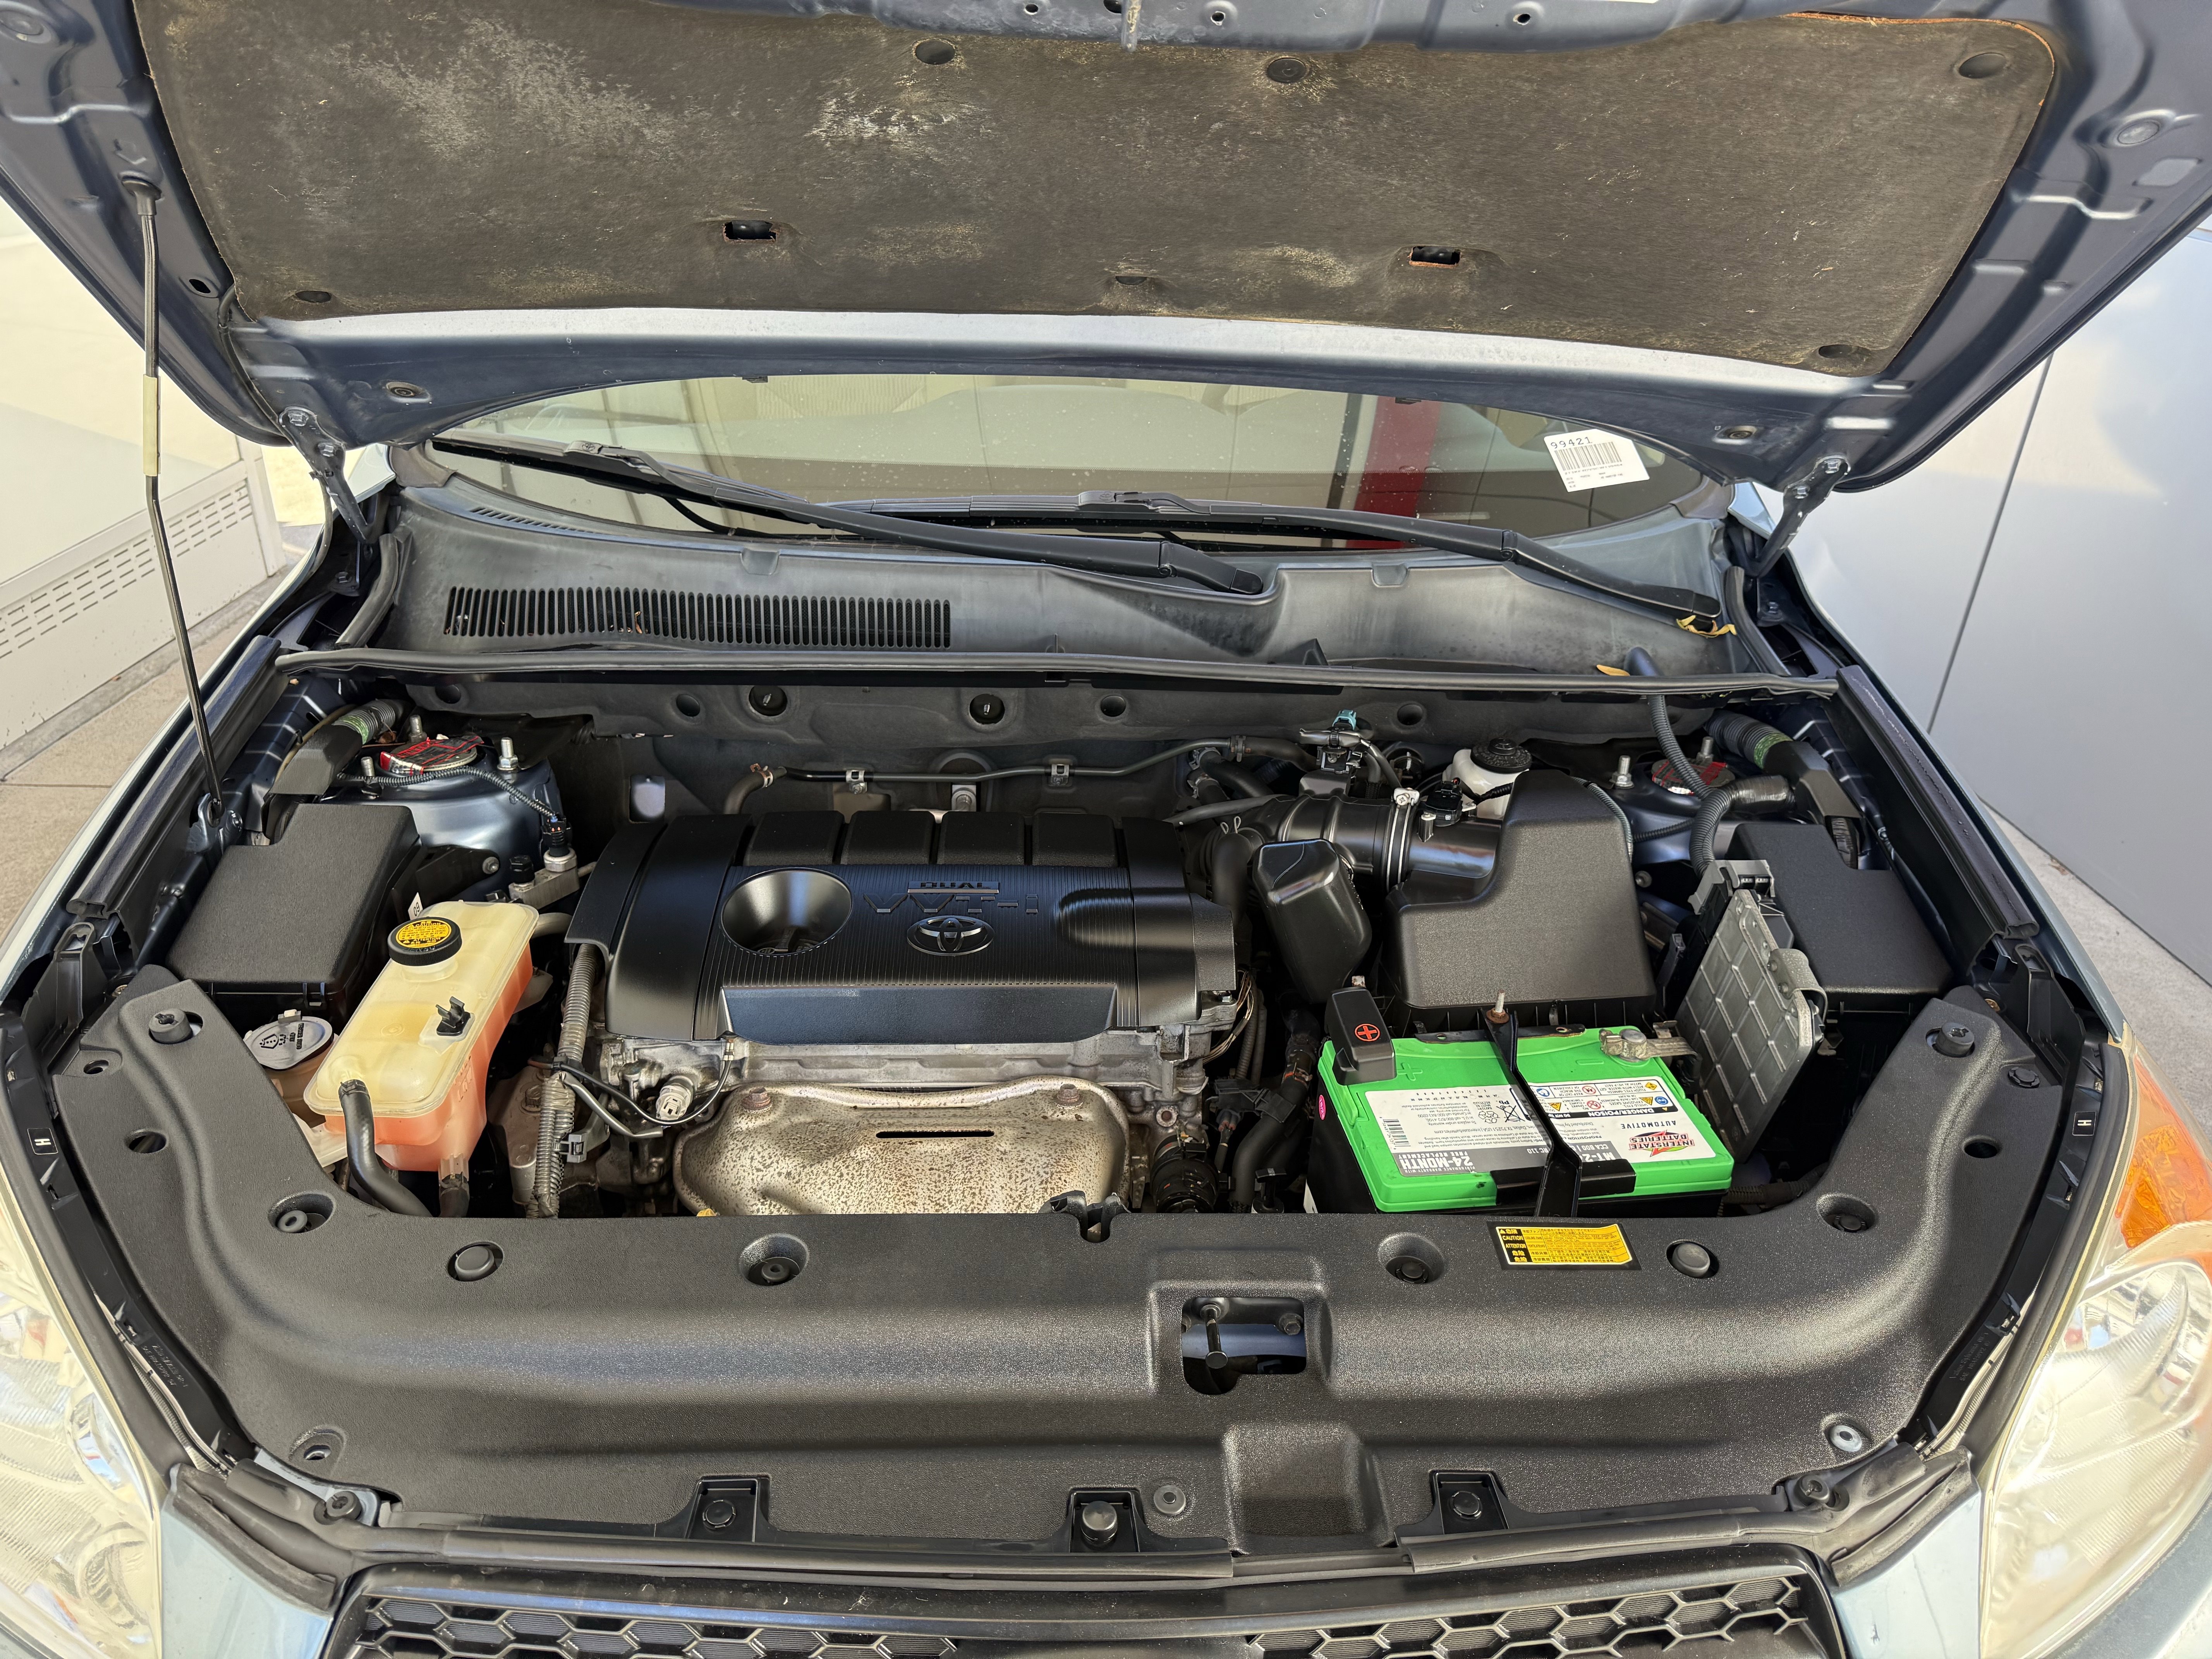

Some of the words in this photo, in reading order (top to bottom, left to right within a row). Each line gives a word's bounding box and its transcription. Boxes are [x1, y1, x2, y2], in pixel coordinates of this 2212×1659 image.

[1551, 436, 1593, 449] 99421
[1588, 1108, 1654, 1116] DANGER/POISON
[1620, 1120, 1676, 1129] AUTOMOTIVE
[1631, 1134, 1687, 1142] BATTERIES
[1630, 1140, 1693, 1149] INTERSTATE
[1579, 1152, 1616, 1162] MT-2
[1400, 1156, 1473, 1170] 24-MONTH
